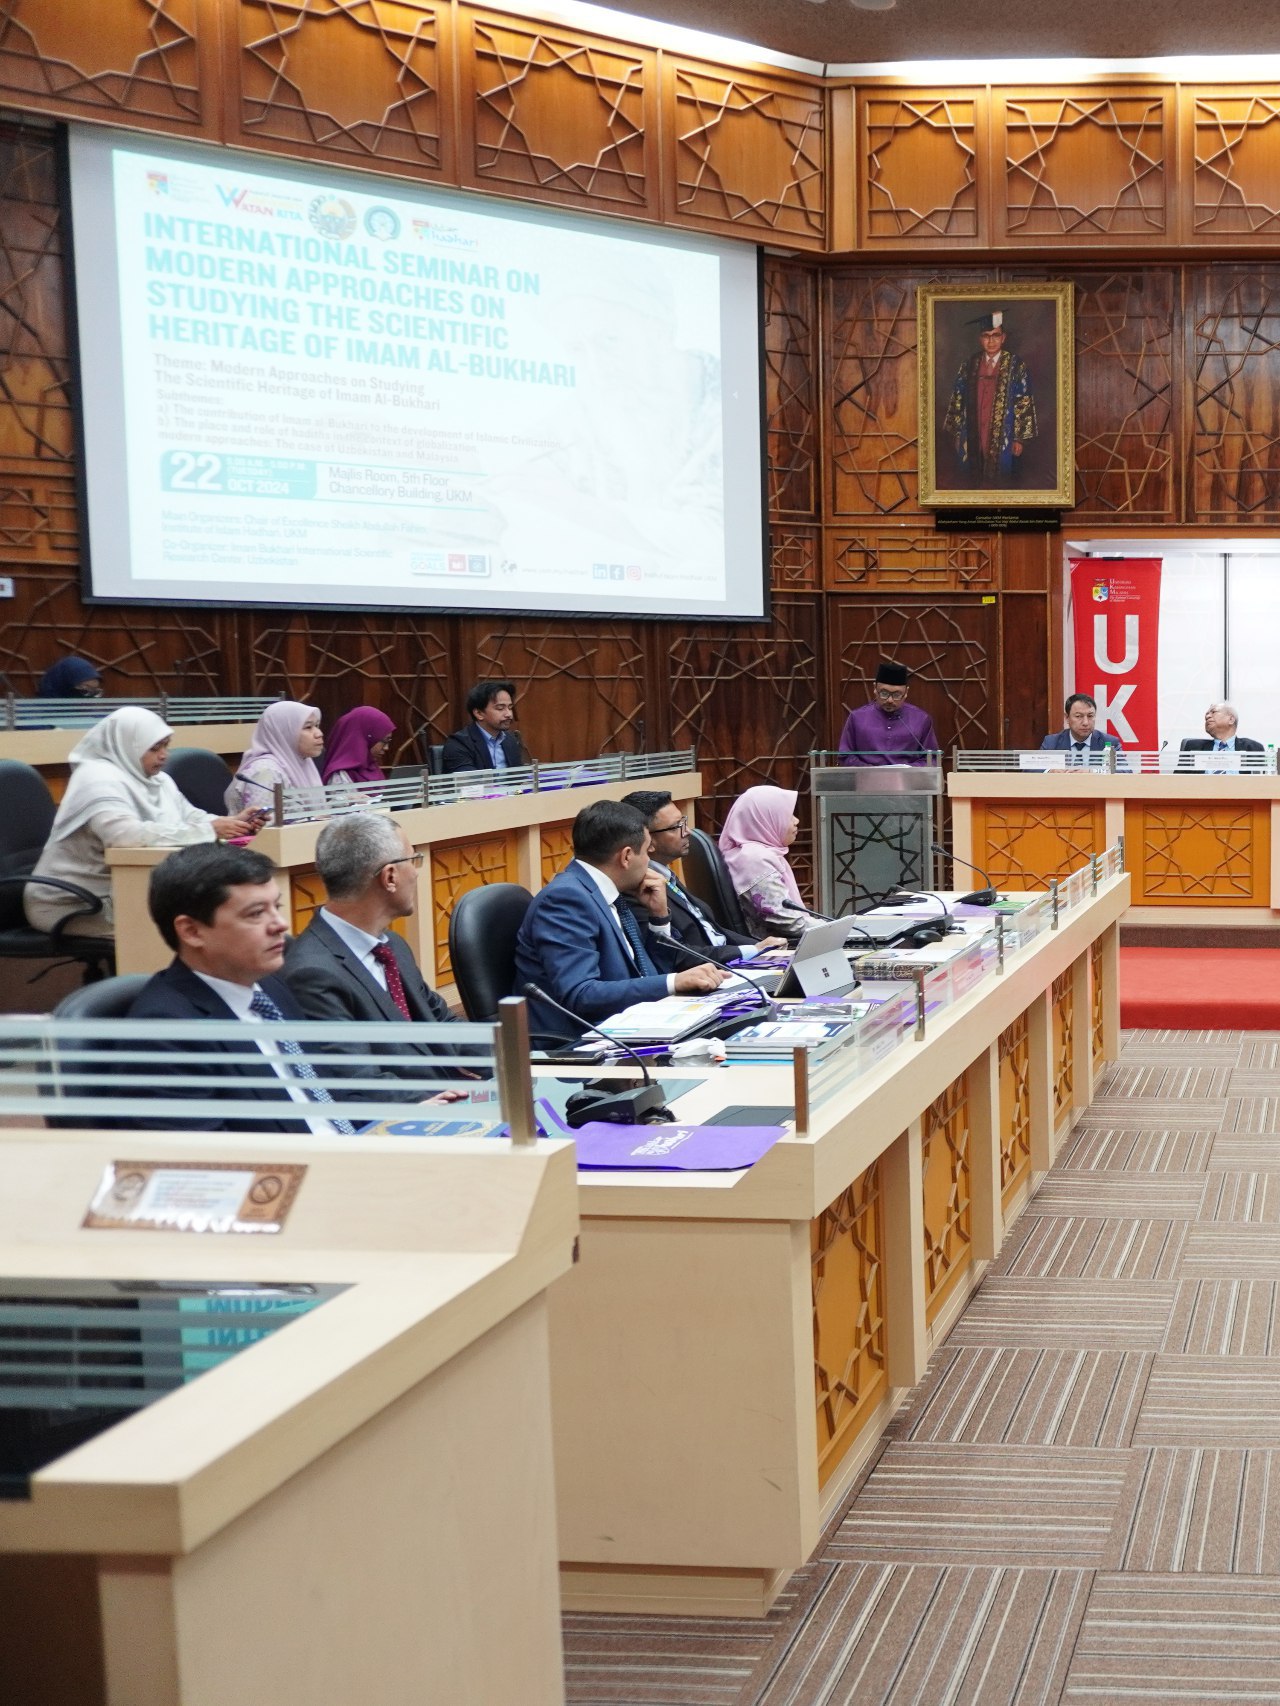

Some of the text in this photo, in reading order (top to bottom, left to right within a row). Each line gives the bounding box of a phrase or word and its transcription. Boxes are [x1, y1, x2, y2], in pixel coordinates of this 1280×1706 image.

[144, 212, 540, 295] INTERNATIONAL SEMINAR ON
[146, 246, 505, 319] MODERN APPROACHES ON
[146, 280, 509, 350] STUDYING THE SCIENTIFIC
[148, 314, 577, 387] HERITAGE OF IMAM AL-BUKHARI
[153, 353, 425, 397] Theme: Modern Approaches on Studying
[153, 369, 441, 411] The Scientific Heritage of Imam Al-Bukhari
[401, 425, 462, 441] development
[476, 432, 509, 445] Islamic
[170, 451, 223, 490] 22
[328, 466, 363, 481] Majlis
[402, 471, 421, 484] 5th
[423, 473, 449, 486] Floor
[328, 481, 395, 498] Chancellory
[446, 489, 473, 502] UKM
